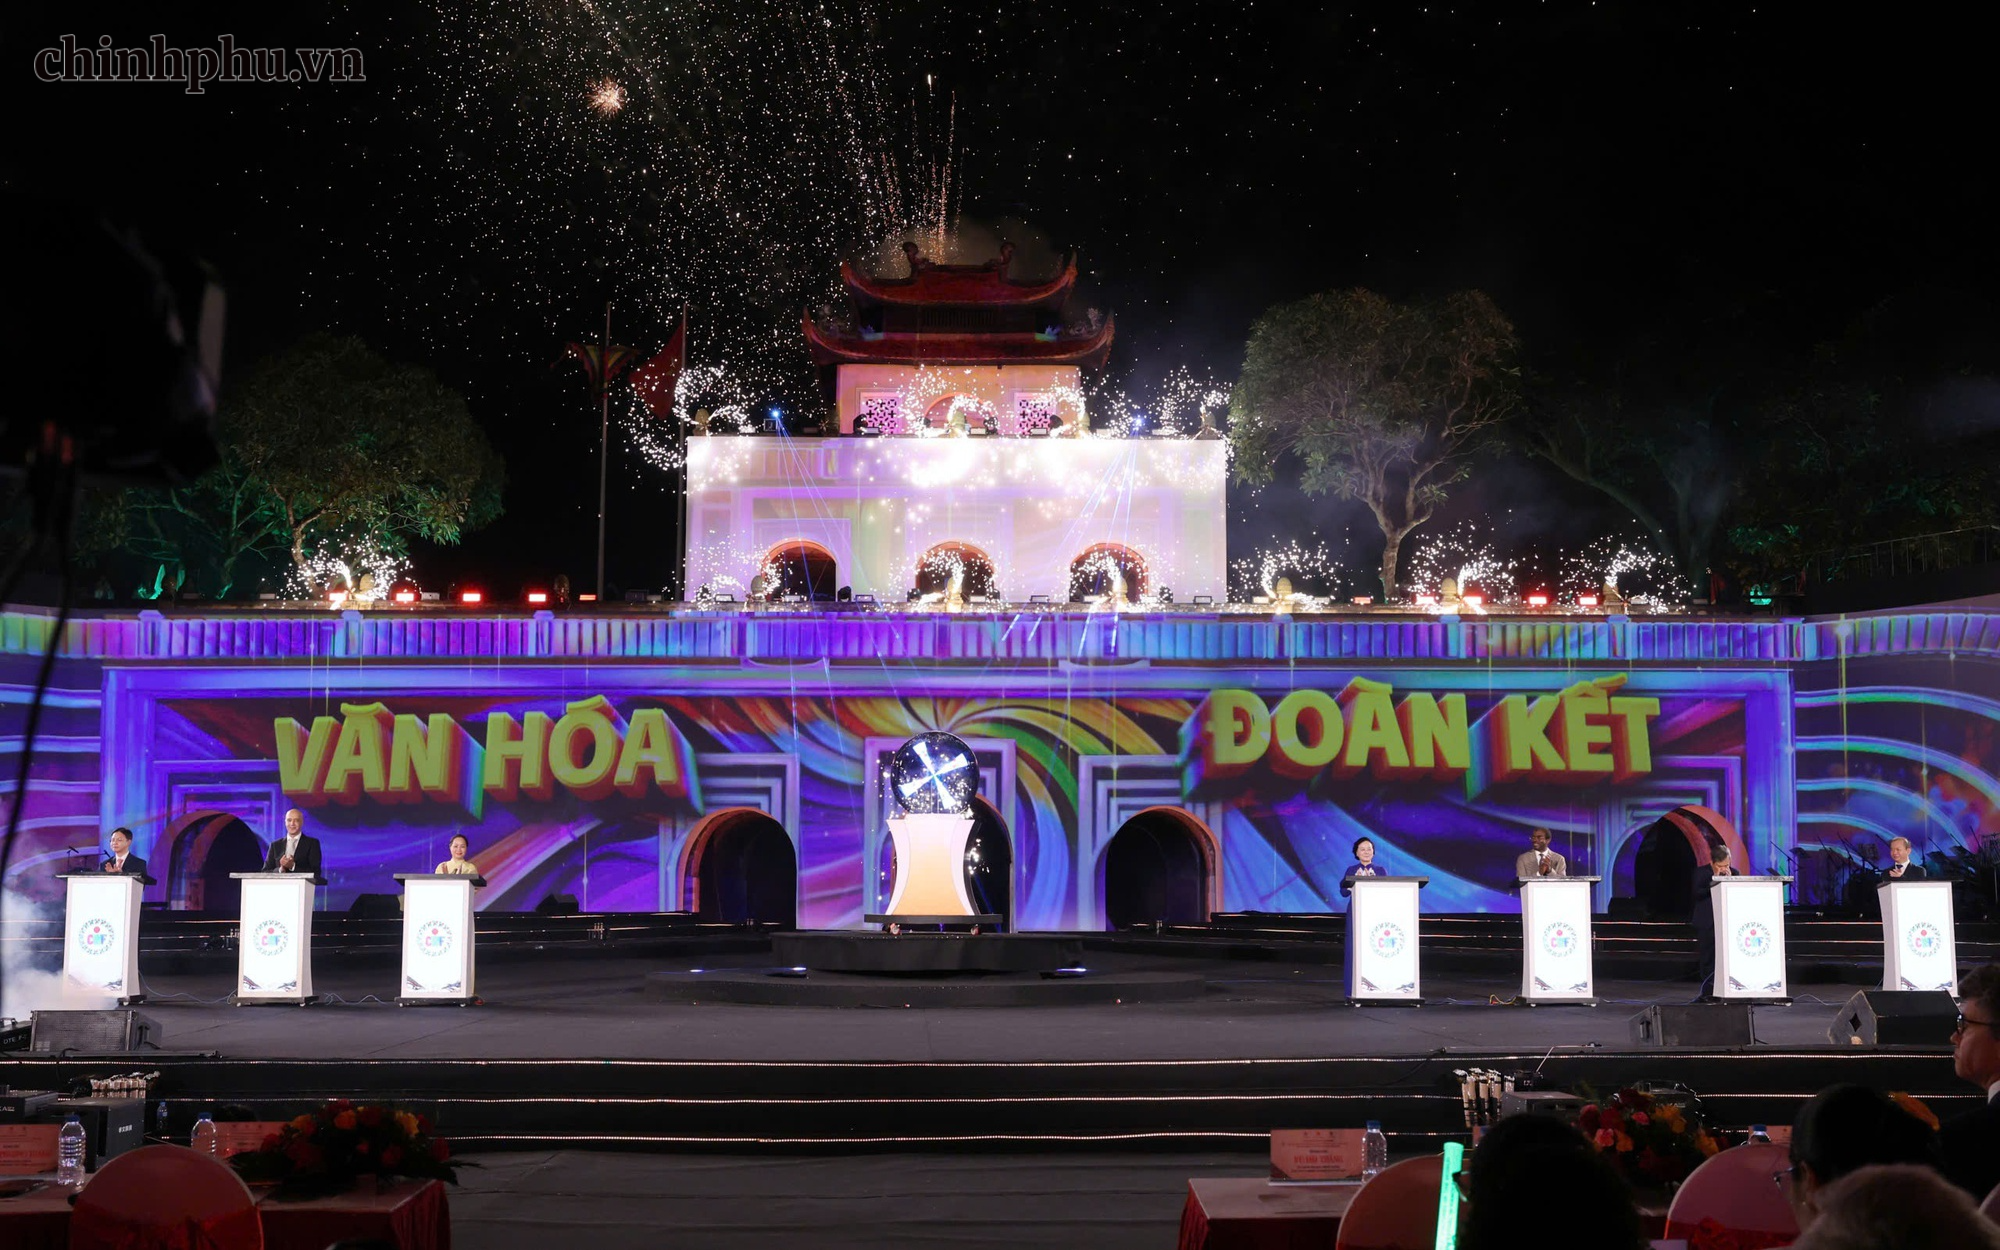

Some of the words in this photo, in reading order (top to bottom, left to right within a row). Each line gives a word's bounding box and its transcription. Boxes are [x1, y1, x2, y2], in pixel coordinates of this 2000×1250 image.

[273, 702, 453, 794] VĂN
[483, 694, 680, 790] HÓA
[1204, 675, 1472, 770] ĐOÀN
[1504, 672, 1662, 773] KẾT
